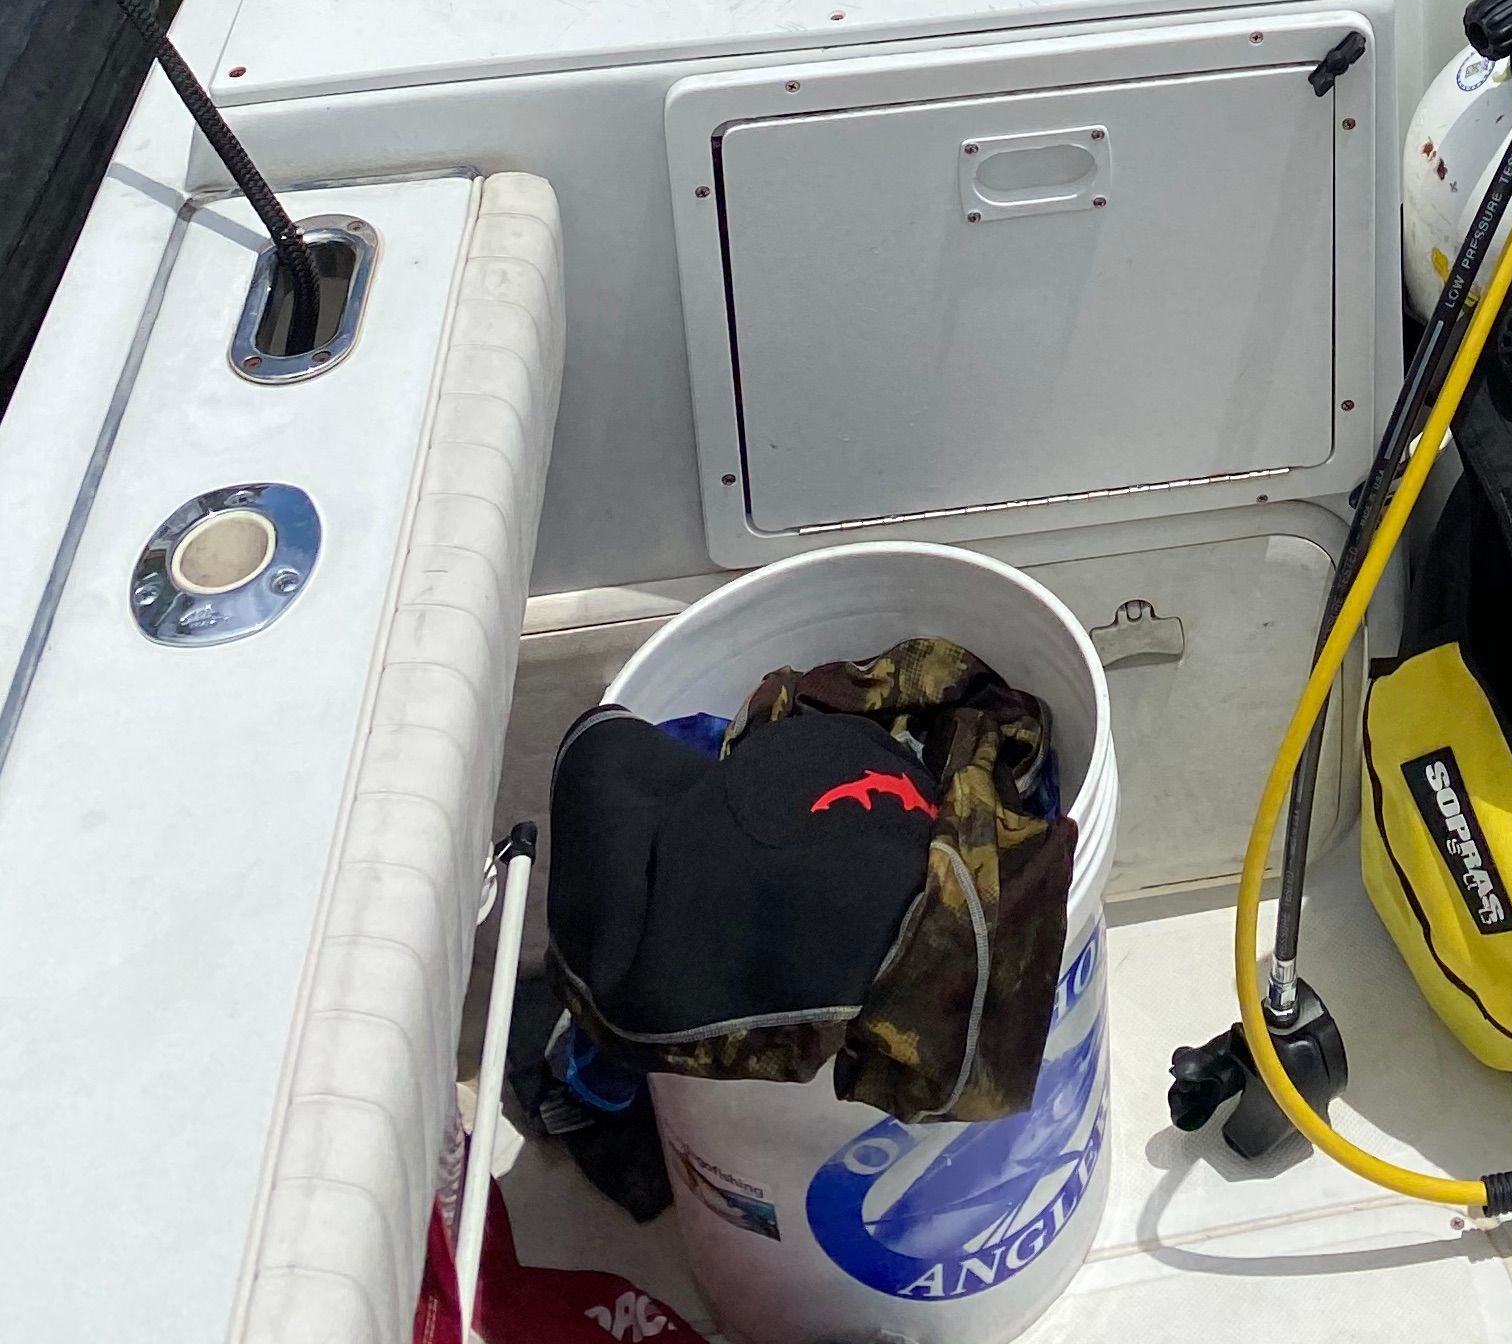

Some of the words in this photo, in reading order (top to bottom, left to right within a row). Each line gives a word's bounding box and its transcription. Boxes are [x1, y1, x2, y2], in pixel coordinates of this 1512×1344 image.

[1444, 273, 1466, 309] LOW
[1460, 192, 1504, 270] PRESSURE
[1425, 760, 1505, 924] SOPRAS
